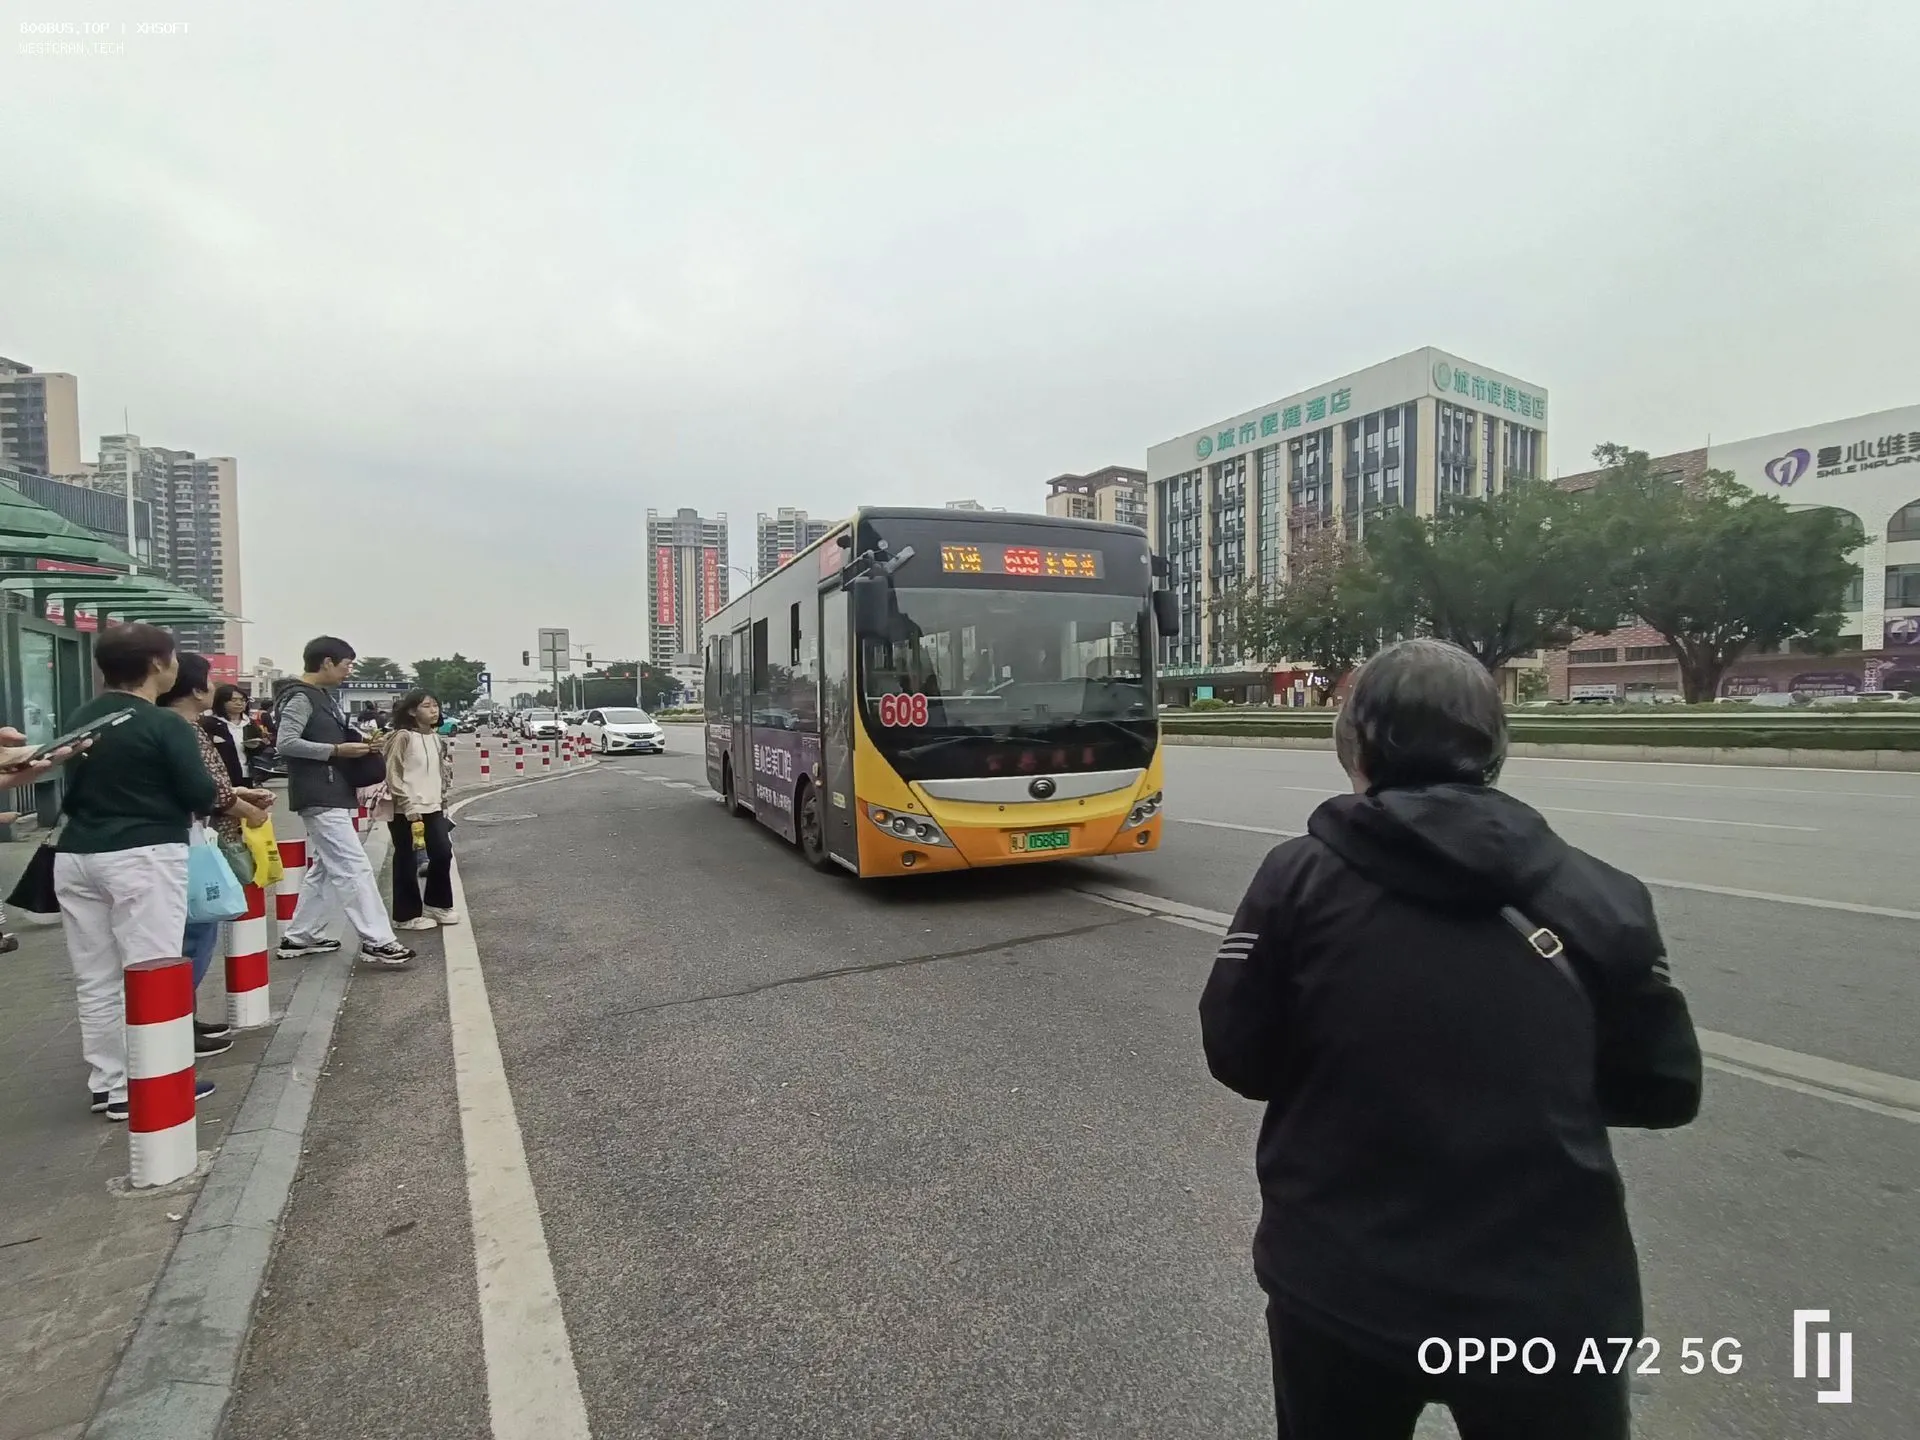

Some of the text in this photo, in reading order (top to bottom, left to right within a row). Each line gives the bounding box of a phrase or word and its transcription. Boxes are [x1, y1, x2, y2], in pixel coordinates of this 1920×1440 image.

[1217, 388, 1352, 451] 城市便捷酒店
[1816, 464, 1857, 479] SMILE
[879, 693, 929, 727] 608
